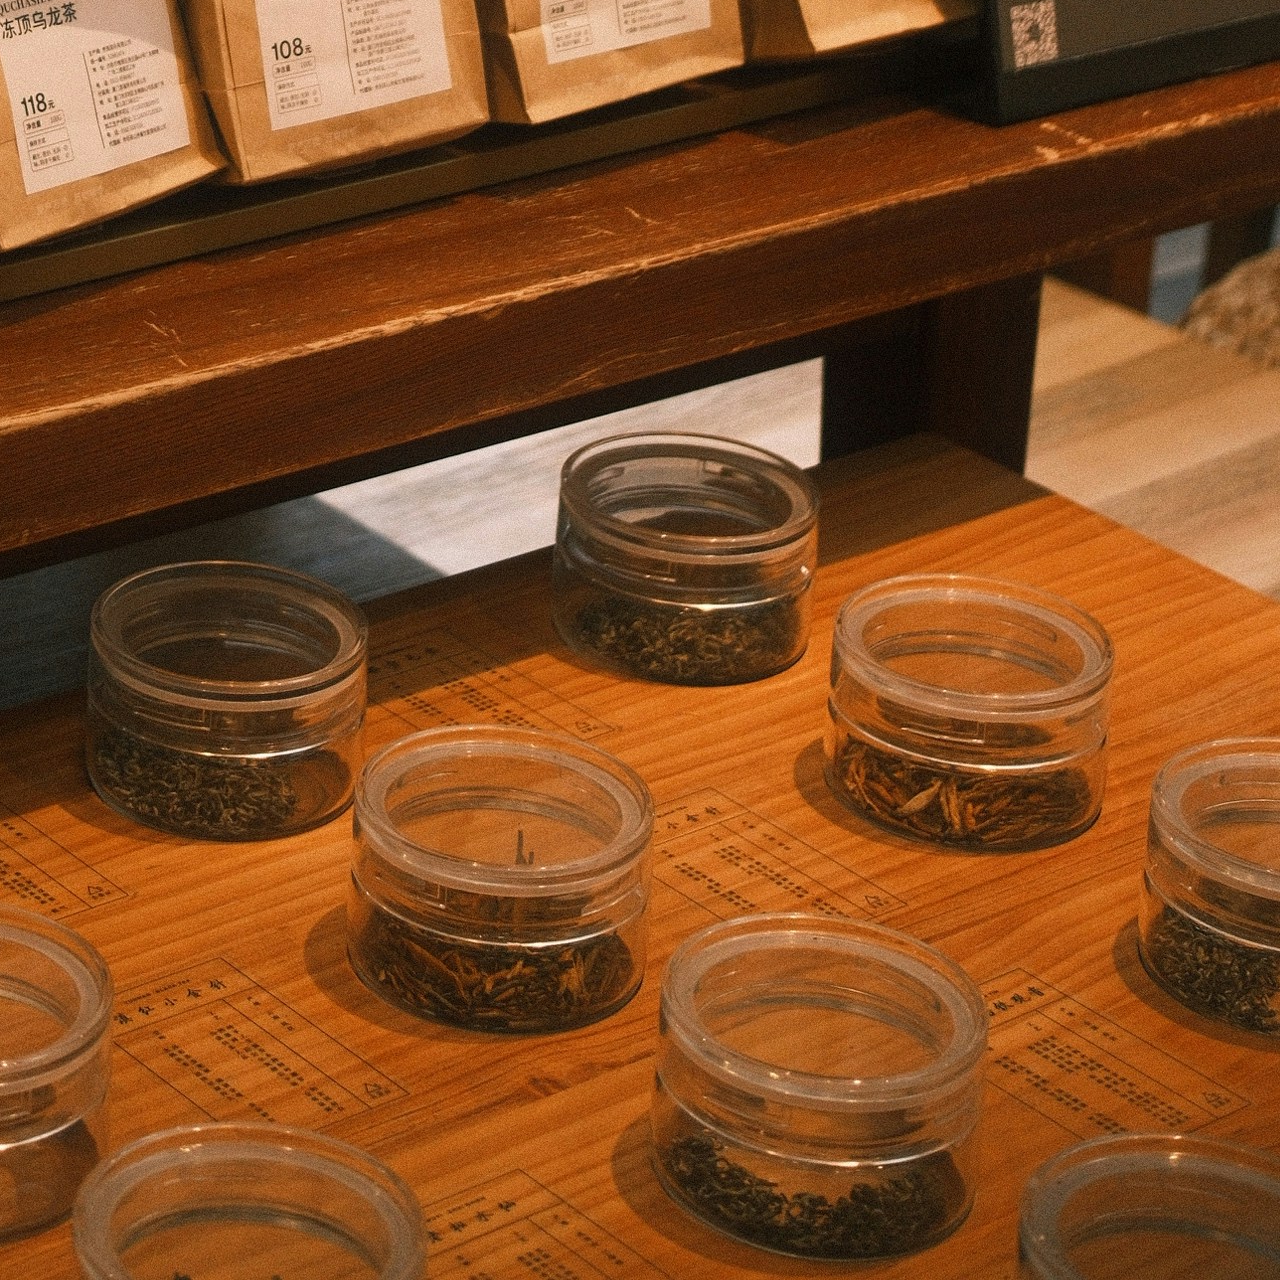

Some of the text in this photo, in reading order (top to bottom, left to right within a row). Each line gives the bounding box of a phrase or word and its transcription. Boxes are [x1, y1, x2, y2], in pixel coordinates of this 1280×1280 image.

[0, 2, 78, 40] 冻顶乌龙茶
[271, 37, 312, 61] 108元
[20, 92, 56, 117] 118元
[989, 986, 1045, 1017] 铁观音
